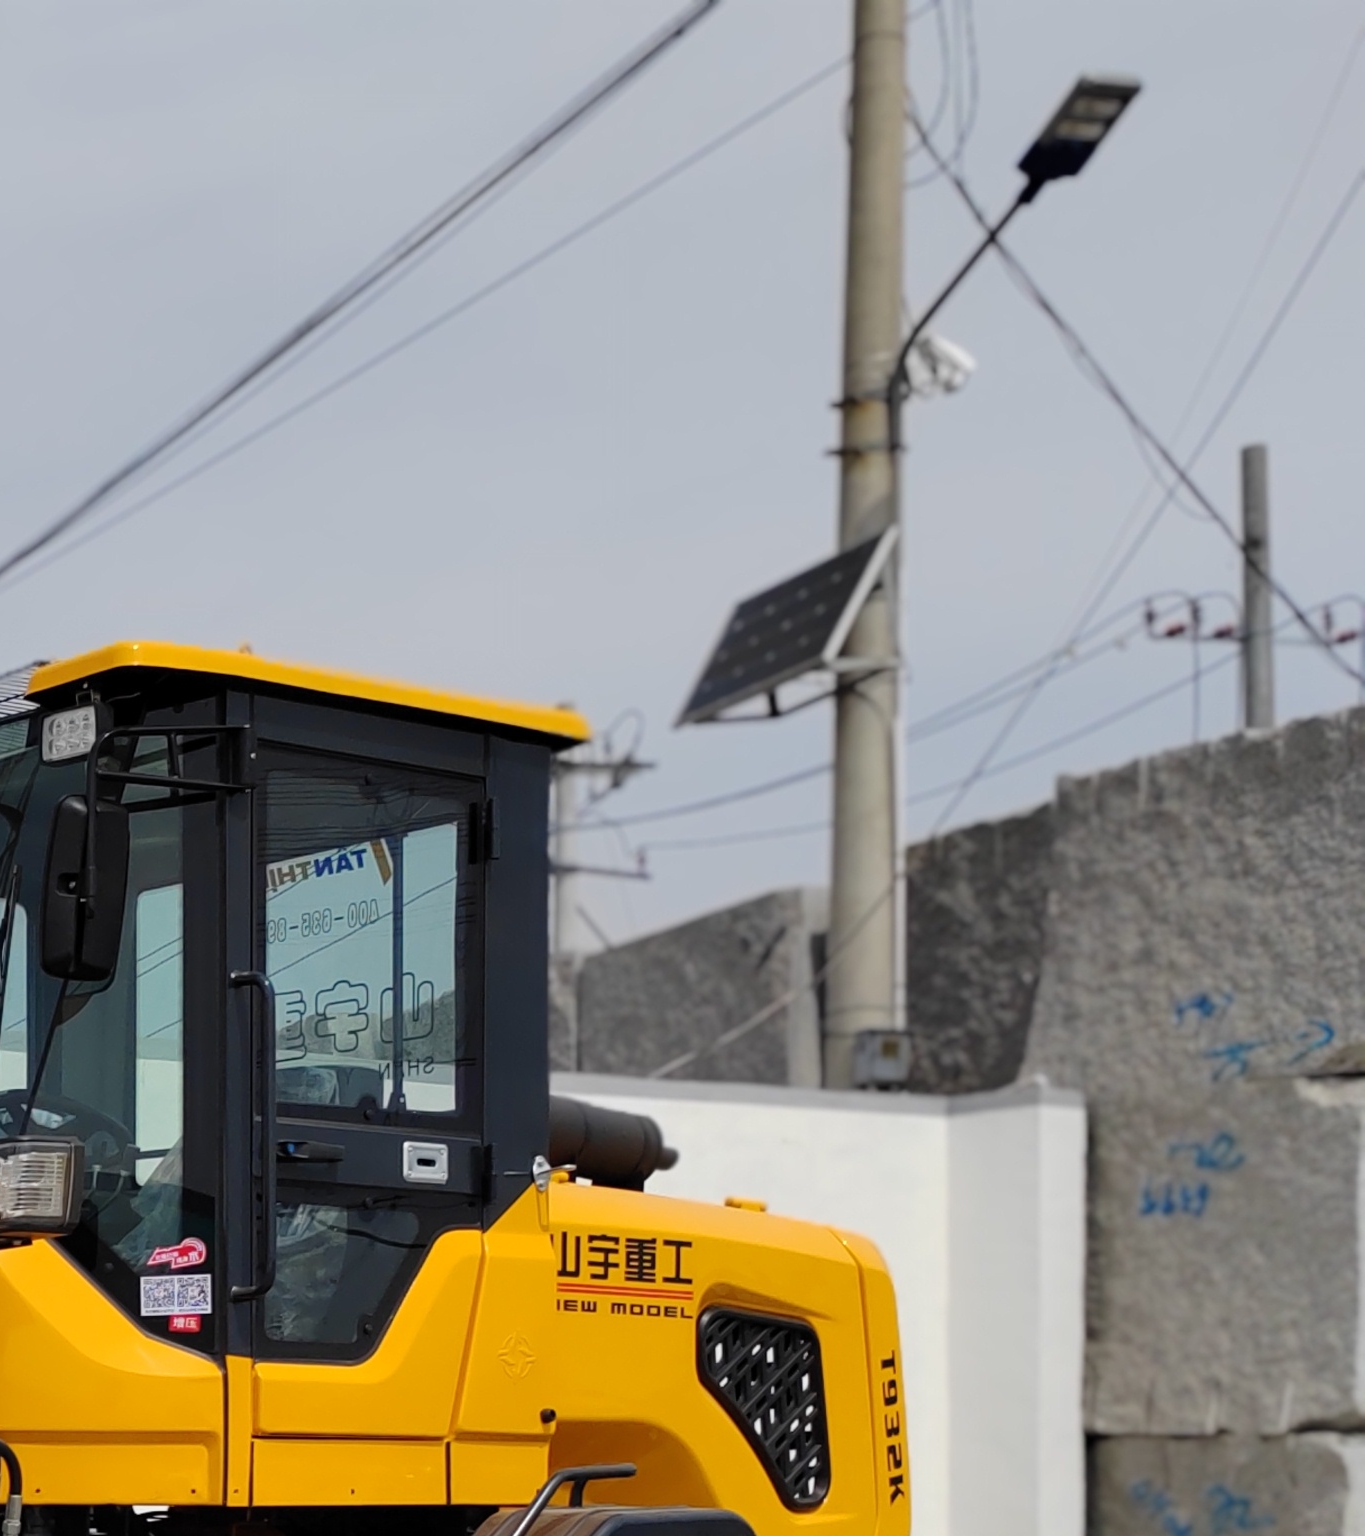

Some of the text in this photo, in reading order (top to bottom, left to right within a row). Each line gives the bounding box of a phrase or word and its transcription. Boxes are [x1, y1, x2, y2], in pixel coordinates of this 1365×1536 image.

[550, 1231, 694, 1285] 山宇重工
[610, 1302, 694, 1319] MODEL
[880, 1350, 905, 1507] T932K
